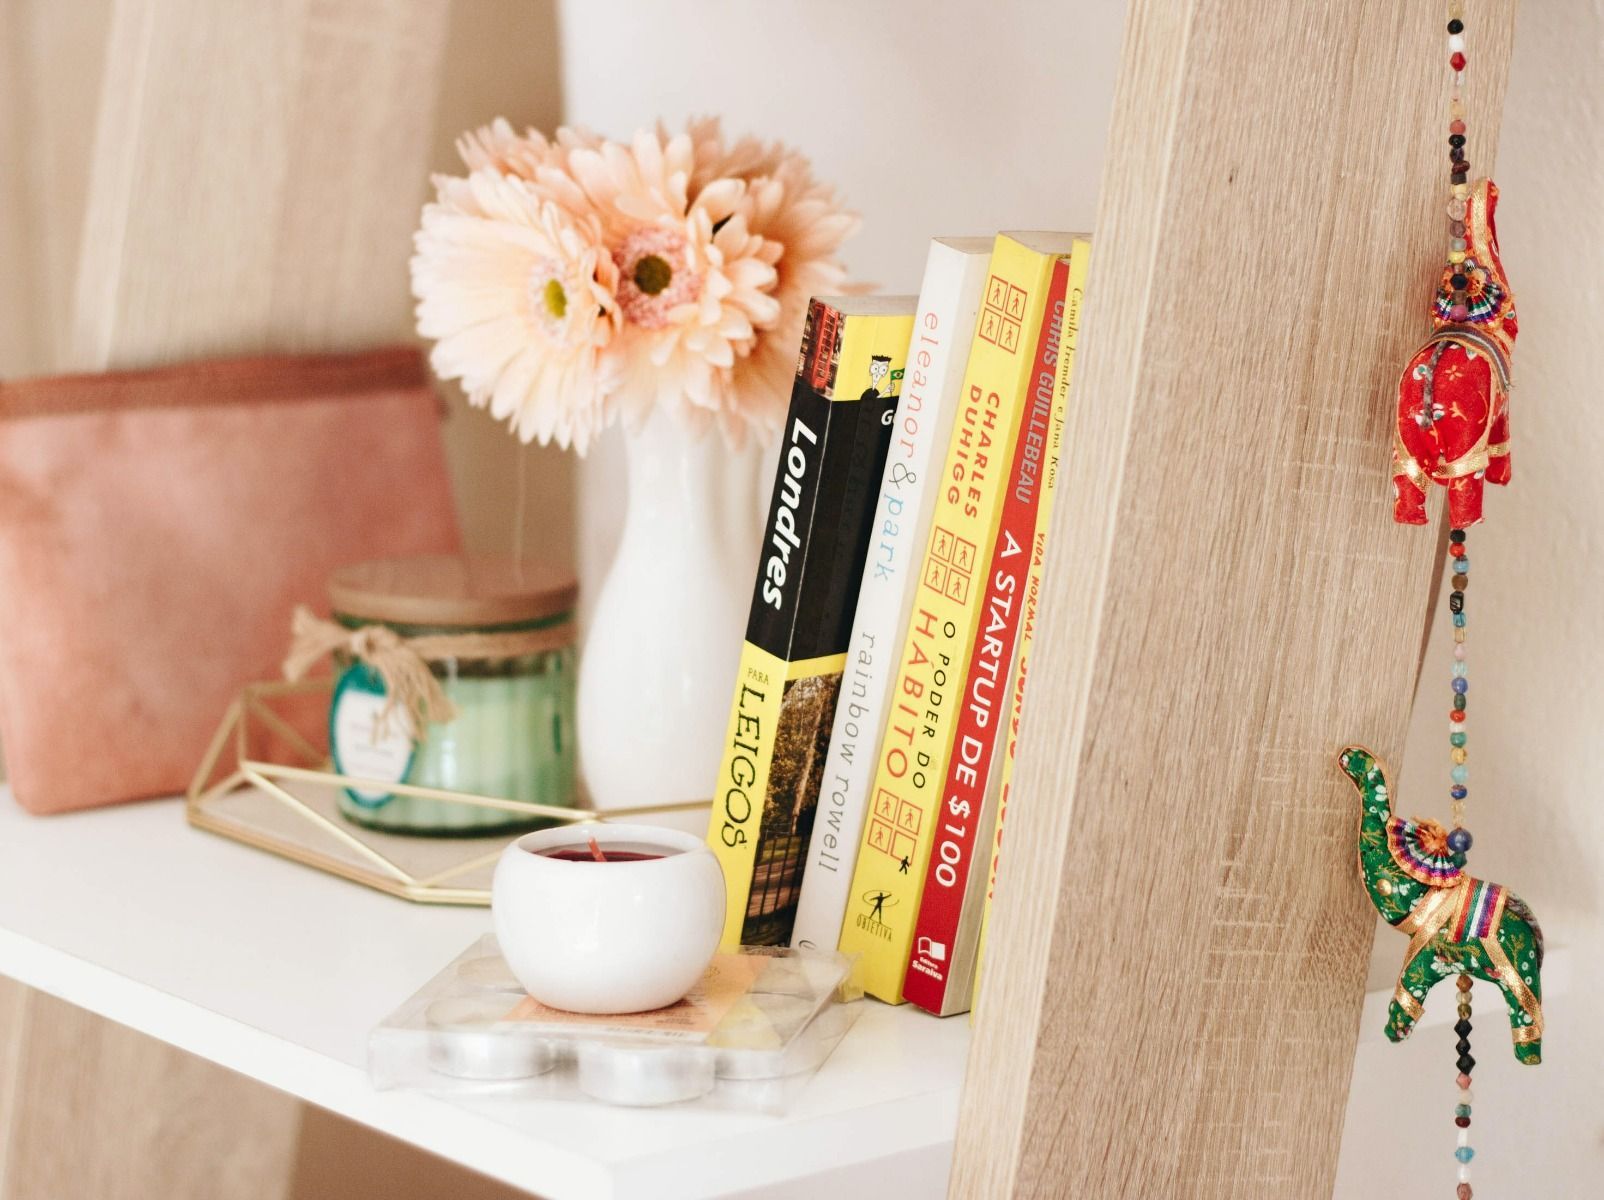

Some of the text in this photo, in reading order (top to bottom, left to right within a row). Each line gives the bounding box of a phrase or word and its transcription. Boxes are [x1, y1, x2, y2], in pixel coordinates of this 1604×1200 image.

[1067, 288, 1083, 338] Camila
[873, 311, 939, 583] eleanor & park
[947, 384, 983, 505] DUHIGG
[964, 391, 1000, 519] CHARLES
[1015, 300, 1066, 504] CHRIS GUILLEBEAU
[762, 417, 818, 610] Londres
[1024, 533, 1045, 641] VIDA NORMAL
[747, 667, 769, 685] PARA
[818, 632, 875, 873] rainbow rowell
[886, 608, 938, 778] HÁBITO
[912, 621, 956, 789] O PODER DO
[935, 529, 1022, 888] A STARTUP DE $100
[721, 683, 765, 847] LEIGOS
[912, 960, 943, 981] Saraiva
